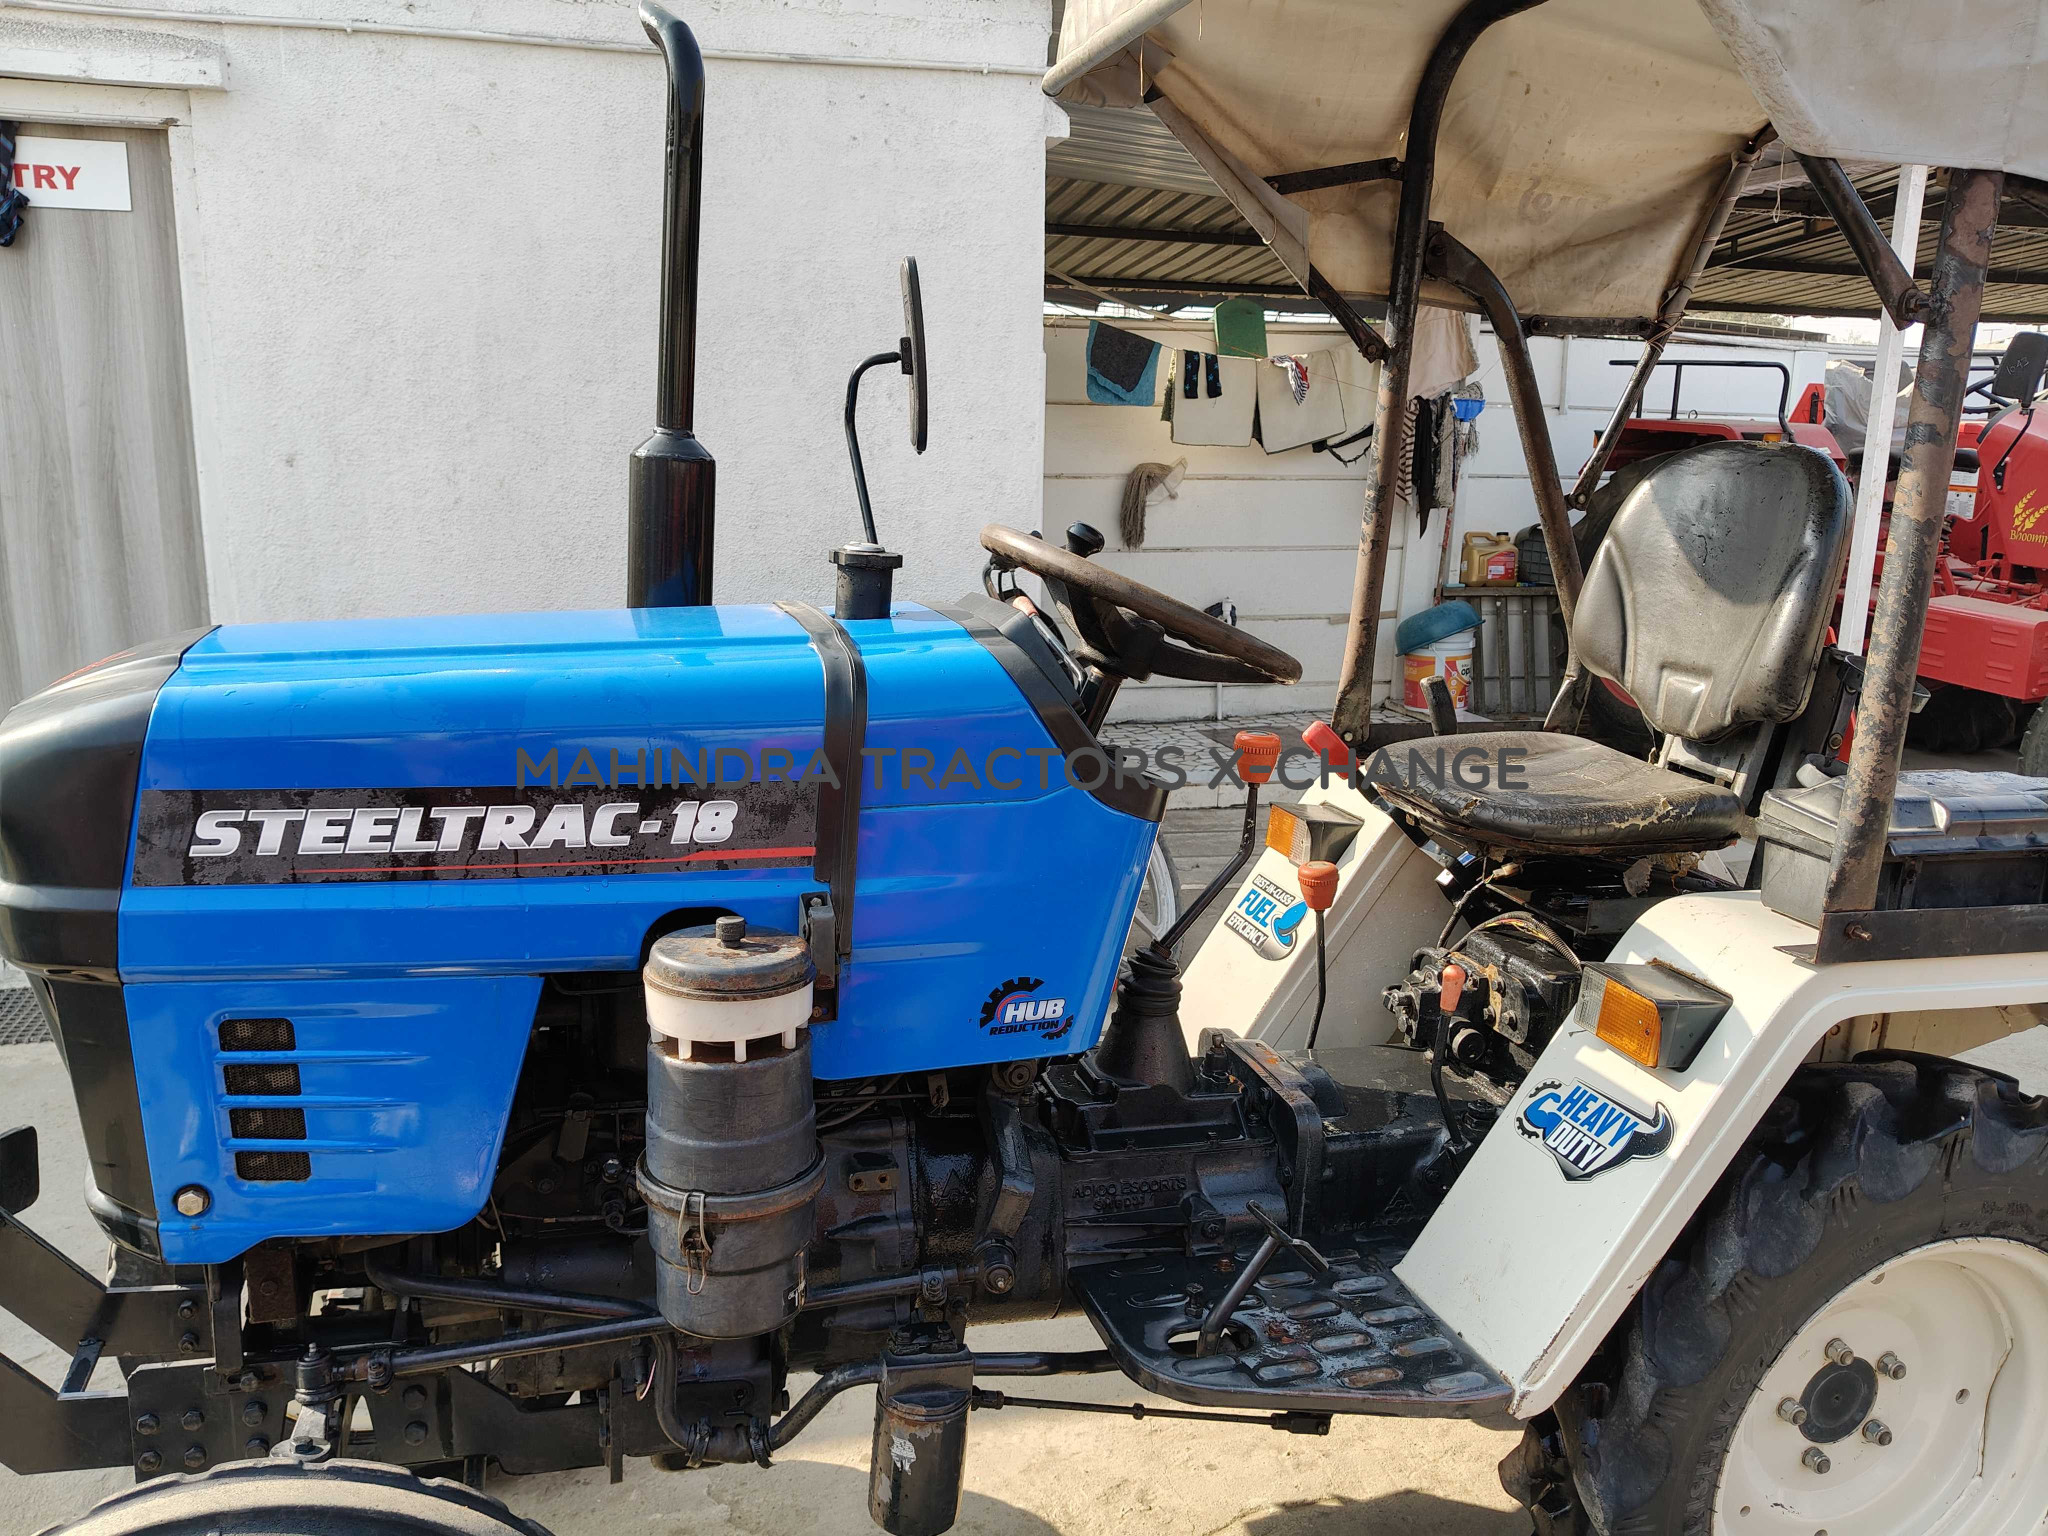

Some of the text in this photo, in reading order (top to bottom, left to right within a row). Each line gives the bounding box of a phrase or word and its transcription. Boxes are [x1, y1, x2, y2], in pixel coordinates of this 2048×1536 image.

[189, 800, 739, 857] STEELTRAC-18
[1237, 888, 1278, 928] FUEL
[1252, 875, 1295, 905] BEST-IN-CLASS
[1226, 913, 1268, 947] EFFICIENCY
[989, 1020, 1060, 1036] REDUCTION
[1003, 998, 1066, 1024] HUB
[1556, 1085, 1640, 1148] HEAVY
[1545, 1121, 1607, 1169] DUTY
